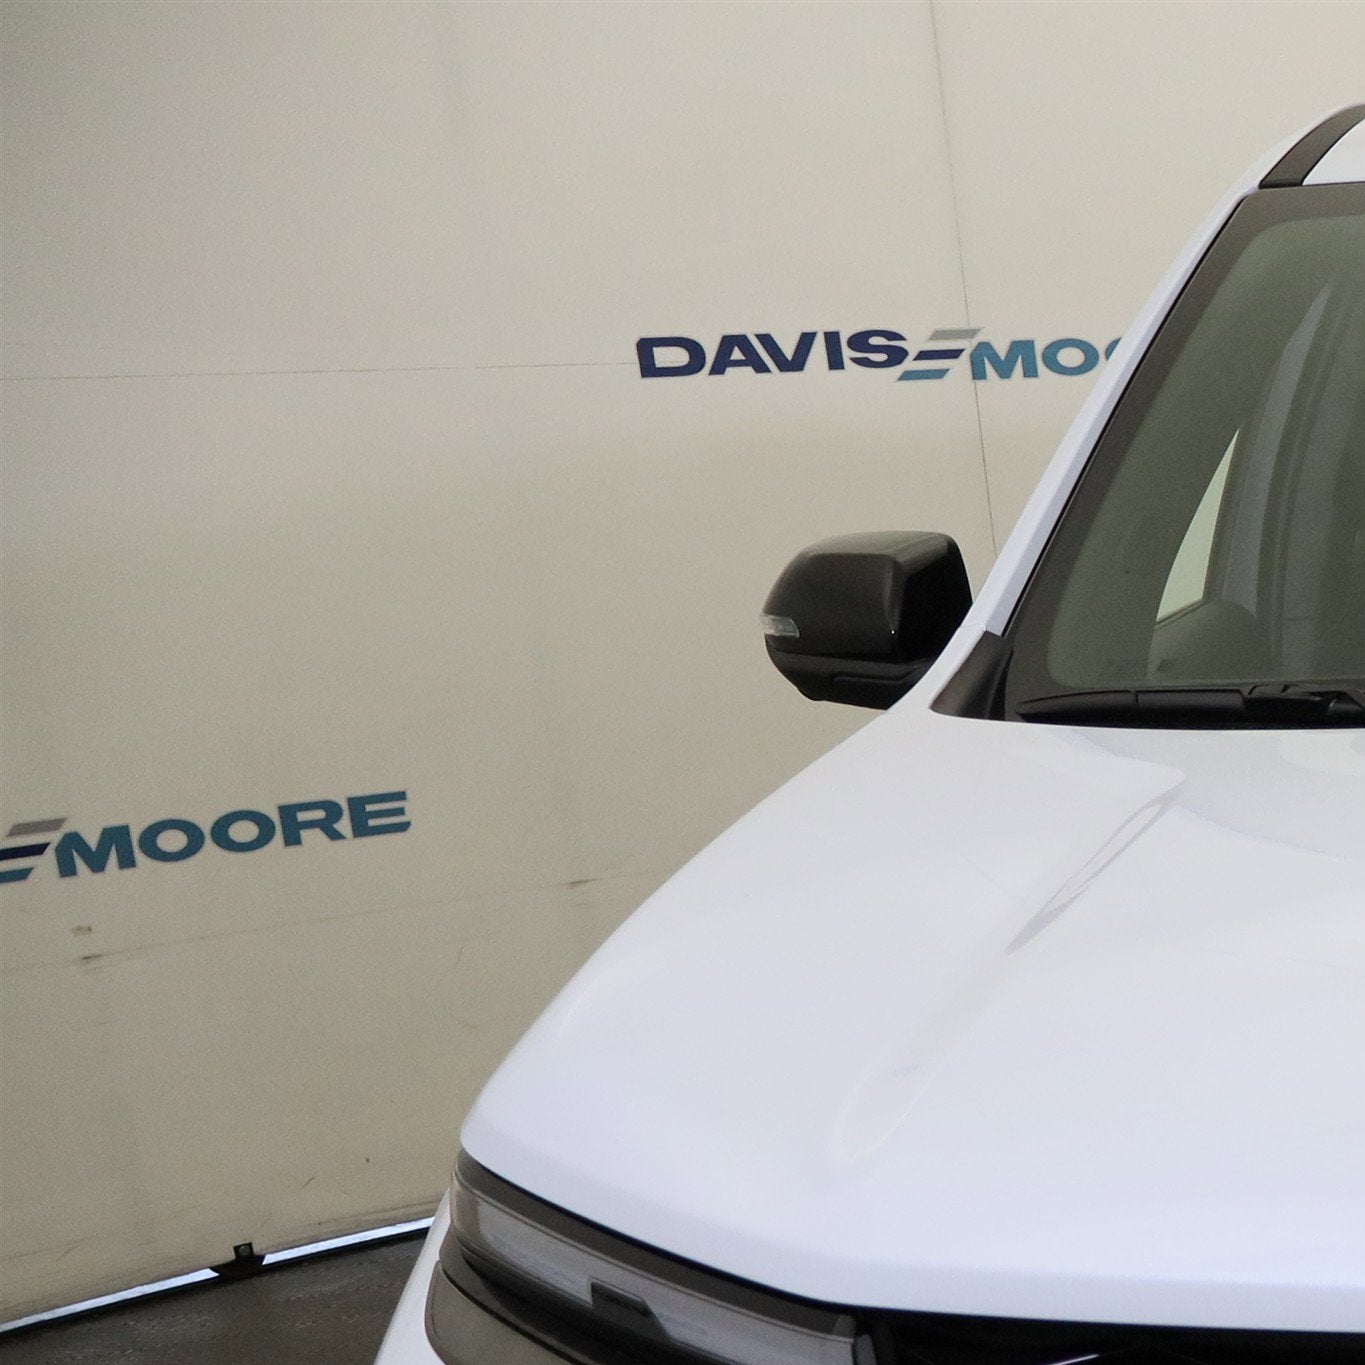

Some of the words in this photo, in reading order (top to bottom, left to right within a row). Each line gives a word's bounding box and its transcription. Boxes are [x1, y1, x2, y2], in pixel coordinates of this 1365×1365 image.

[636, 329, 909, 379] DAVIS
[969, 336, 1122, 381] MO
[54, 790, 412, 879] MOORE
